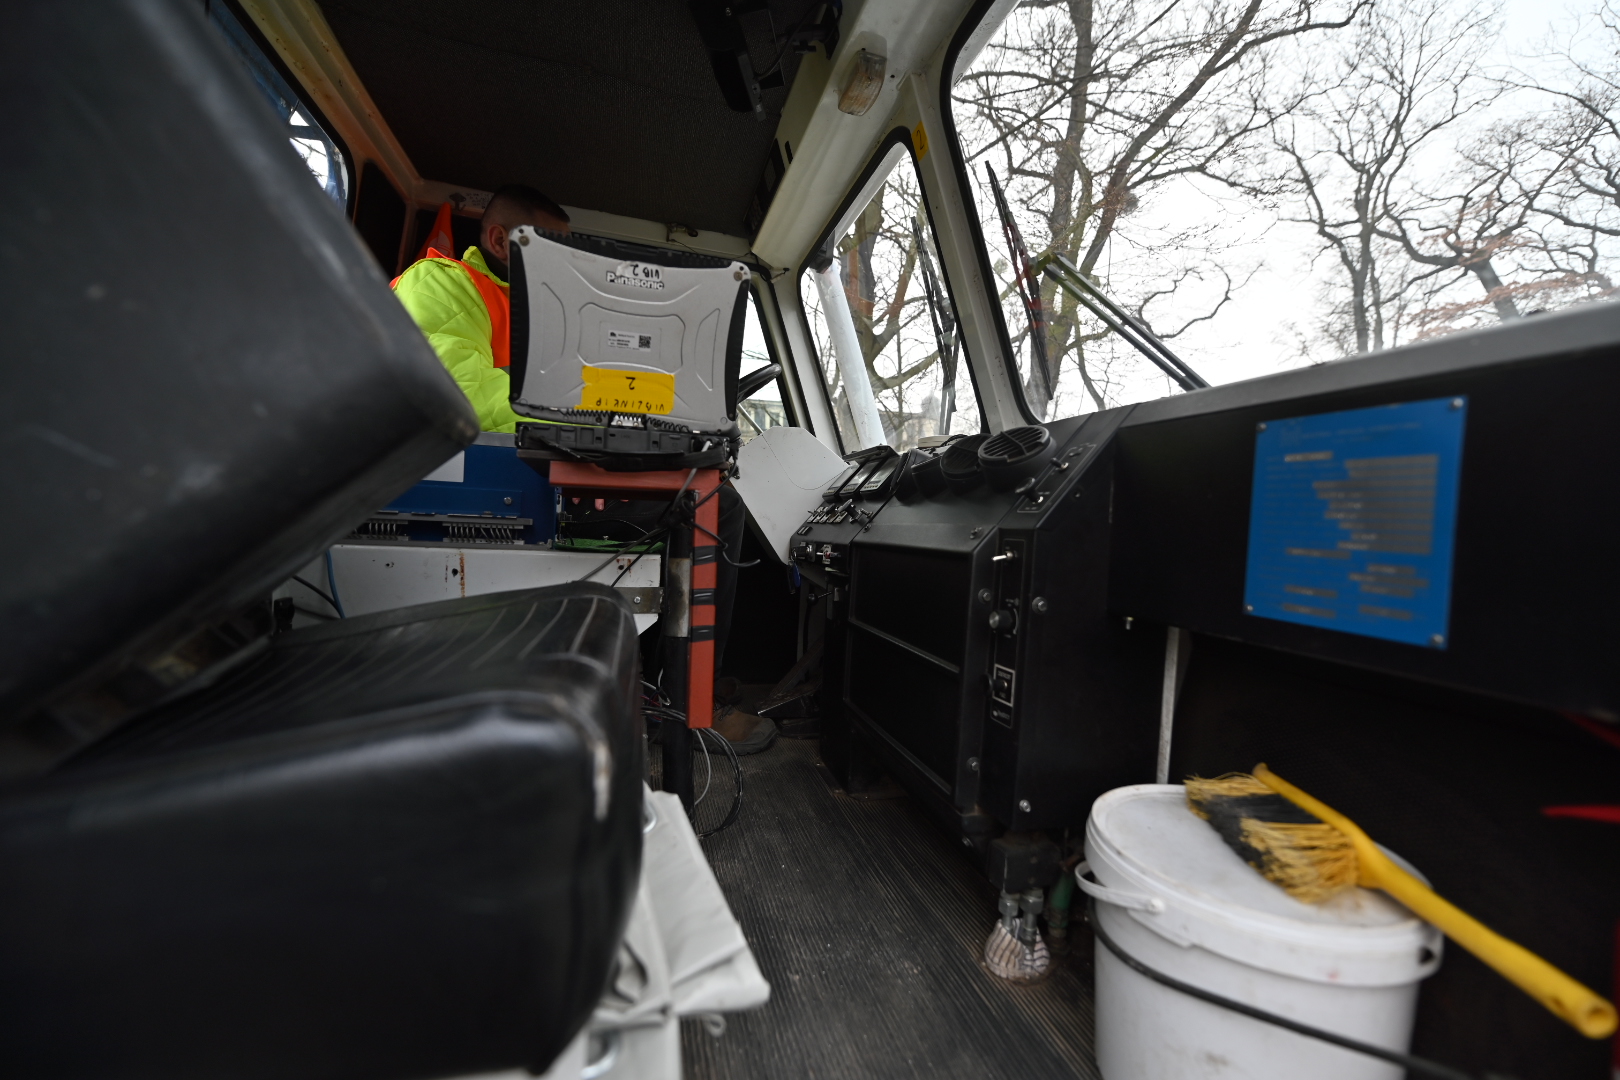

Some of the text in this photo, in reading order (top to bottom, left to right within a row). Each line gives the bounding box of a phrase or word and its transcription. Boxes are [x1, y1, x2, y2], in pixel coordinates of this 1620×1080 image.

[916, 129, 925, 151] 2
[606, 271, 664, 290] Panasonic
[630, 263, 660, 280] VIB 2
[625, 376, 636, 390] 2
